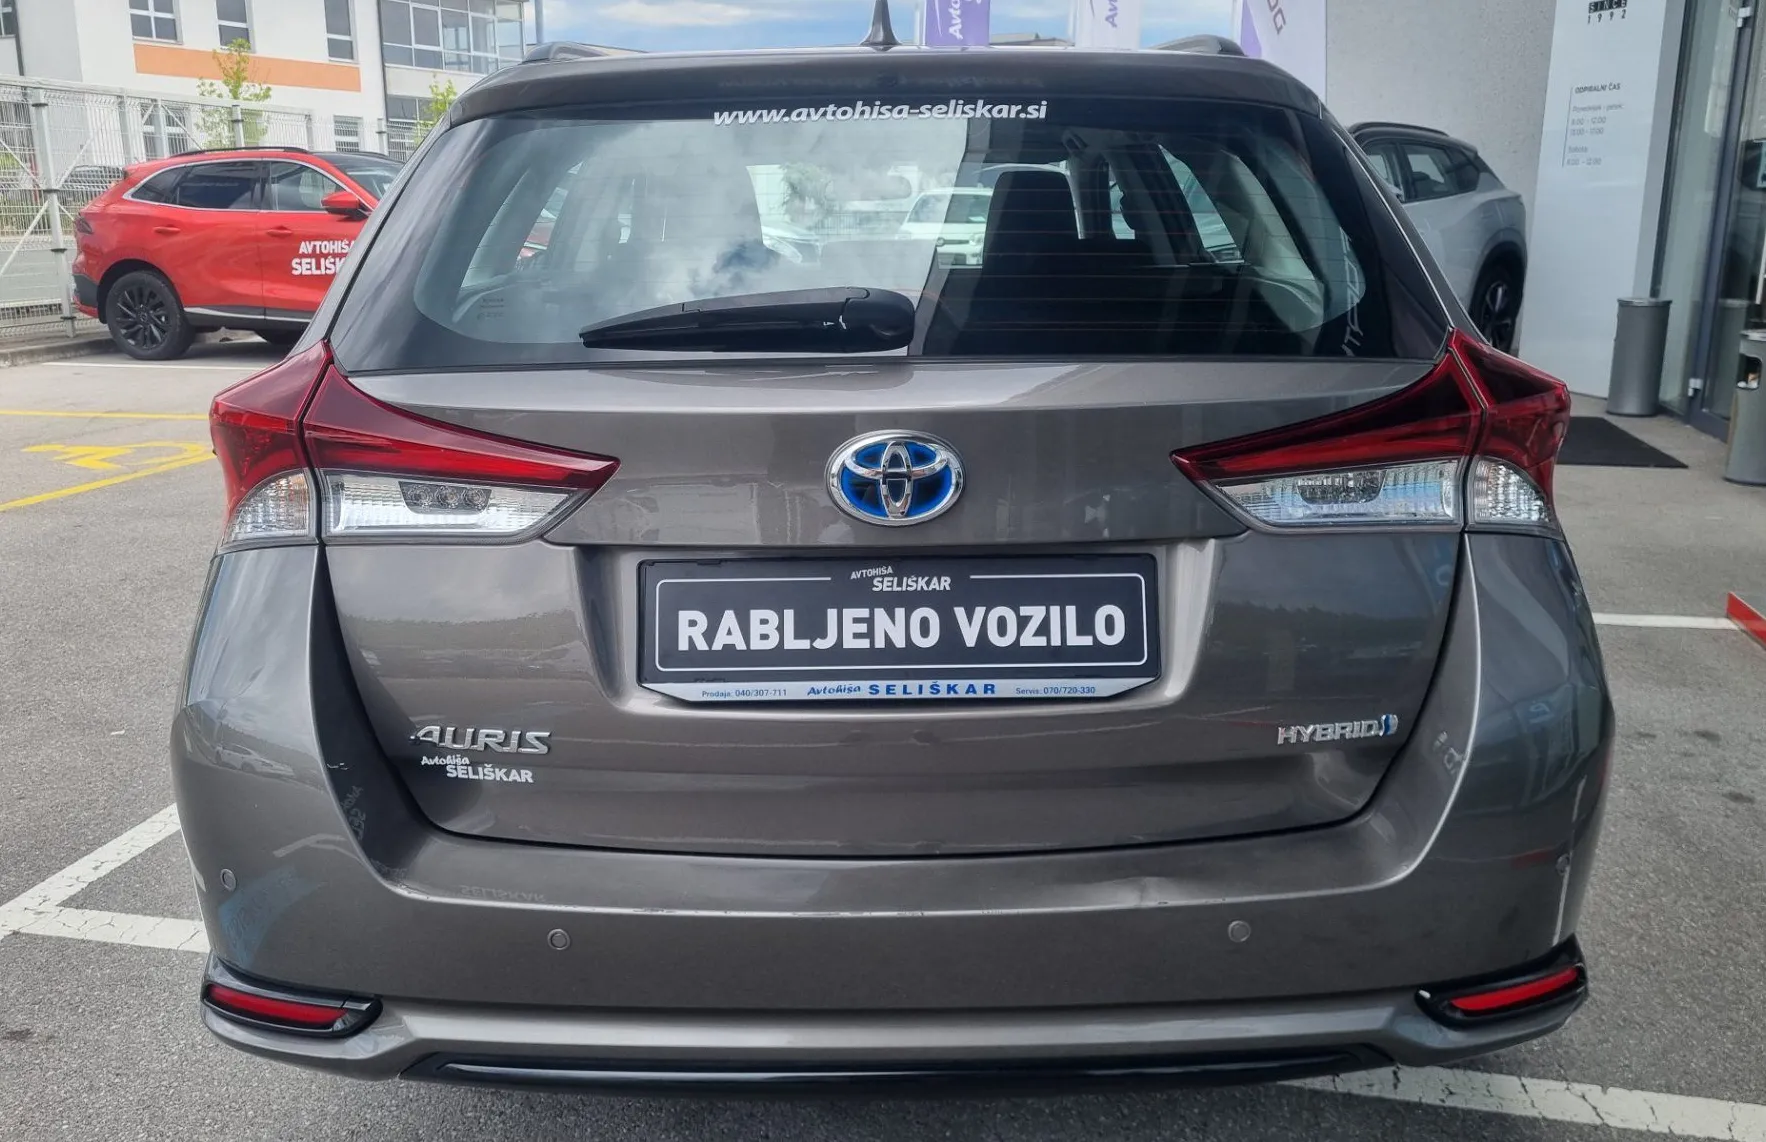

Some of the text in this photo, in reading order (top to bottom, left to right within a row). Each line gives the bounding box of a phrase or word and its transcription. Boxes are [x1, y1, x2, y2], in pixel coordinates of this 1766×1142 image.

[713, 99, 1048, 125] www.avtohisa-seliskar.si
[850, 565, 894, 580] AVTOHIŠA
[871, 575, 952, 592] SELIŠKAR
[677, 604, 1127, 651] RABLJENO VOZILO
[735, 688, 788, 698] 040/307-711
[807, 681, 996, 696] Avtohiša SELIŠKAR
[1043, 686, 1096, 695] 070/720-330
[410, 725, 551, 755] AURIS
[1277, 719, 1381, 745] HYBRID
[421, 753, 470, 766] Avtohiša
[446, 763, 534, 783] SELIŠKAR
